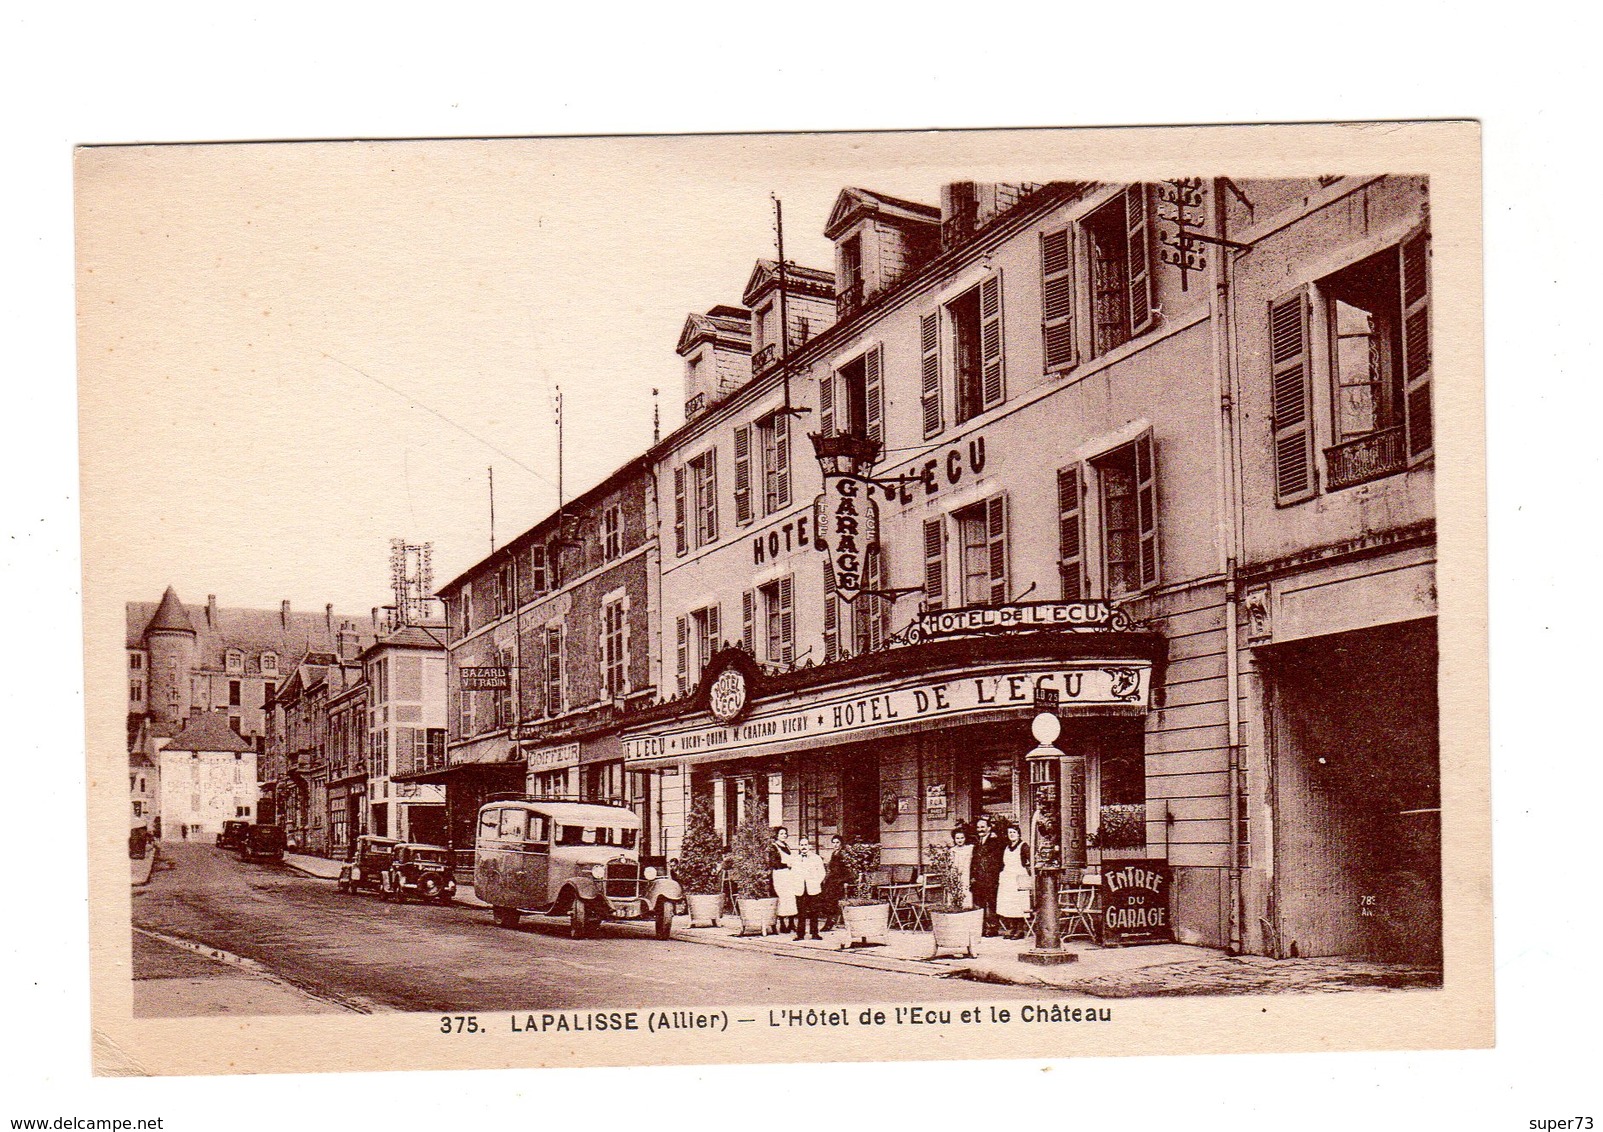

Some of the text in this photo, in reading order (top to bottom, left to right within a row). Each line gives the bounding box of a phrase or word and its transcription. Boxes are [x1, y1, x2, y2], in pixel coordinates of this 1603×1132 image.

[753, 516, 809, 566] HOTE
[835, 478, 859, 591] GARAGE
[931, 609, 995, 633] HOTEL
[1032, 604, 1099, 622] L'ECU
[714, 674, 741, 698] HOTEL
[743, 720, 777, 740] CHATARD
[782, 715, 809, 734] VICHY
[833, 694, 898, 728] HOTEL
[913, 684, 950, 714] DE
[974, 672, 1084, 704] L'ECU
[528, 744, 579, 767] COIFFEUR
[1127, 896, 1145, 905] DU
[1105, 905, 1166, 929] GARAGE
[440, 1015, 486, 1034] 375.
[511, 1012, 639, 1033] LAPALISSE
[648, 1010, 729, 1033] (Allier)
[769, 1008, 849, 1027] L'Hôtel
[859, 1008, 886, 1026] de
[895, 1006, 951, 1025] l'Ecu
[960, 1007, 981, 1024] et
[990, 1006, 1011, 1023] le
[1021, 1003, 1112, 1023] Château
